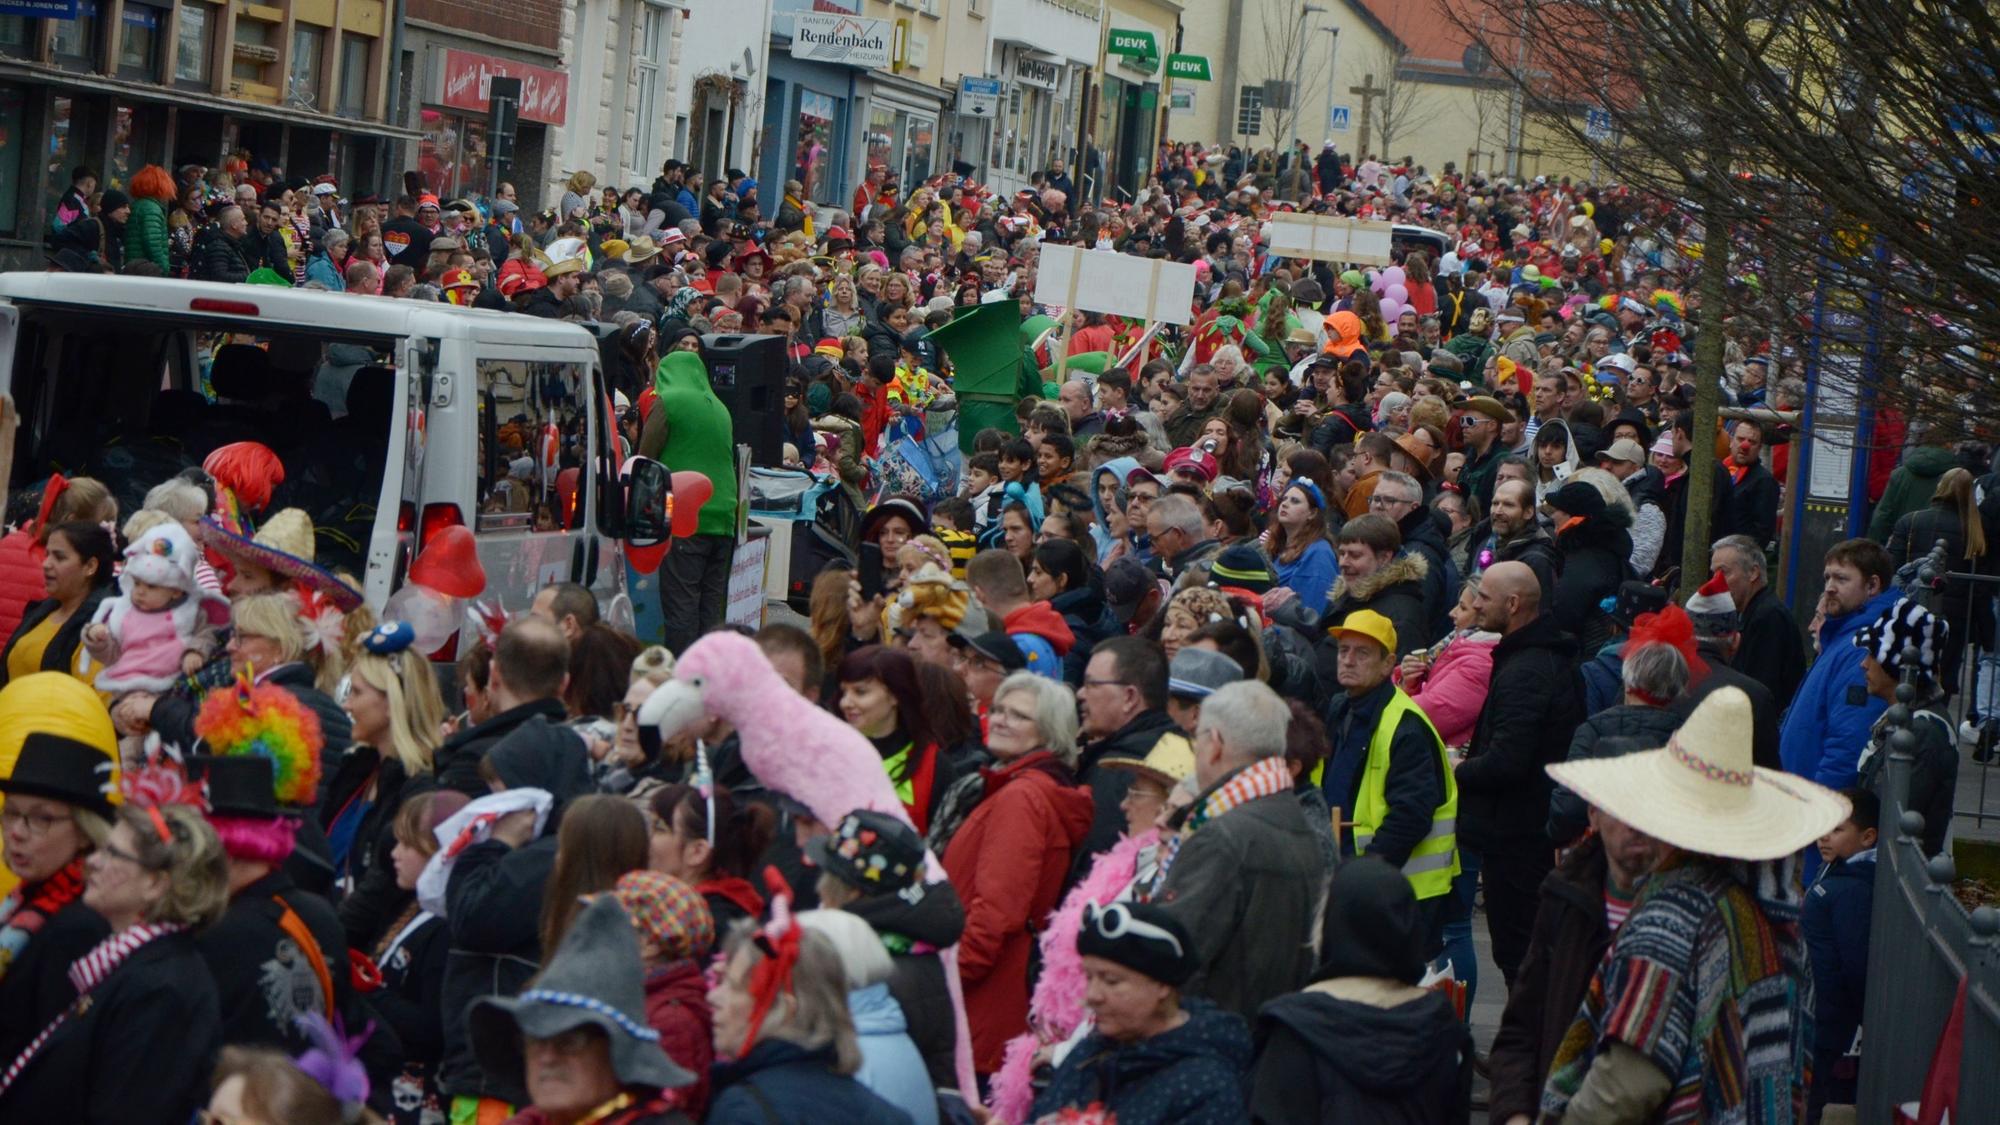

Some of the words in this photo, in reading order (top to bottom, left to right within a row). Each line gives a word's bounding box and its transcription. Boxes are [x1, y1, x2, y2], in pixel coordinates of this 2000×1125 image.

[802, 17, 835, 25] SANITÄR
[800, 28, 883, 50] Rendenbach
[1115, 37, 1147, 49] DEVK
[848, 52, 884, 61] HEIZUNG
[1172, 61, 1201, 72] DEVK
